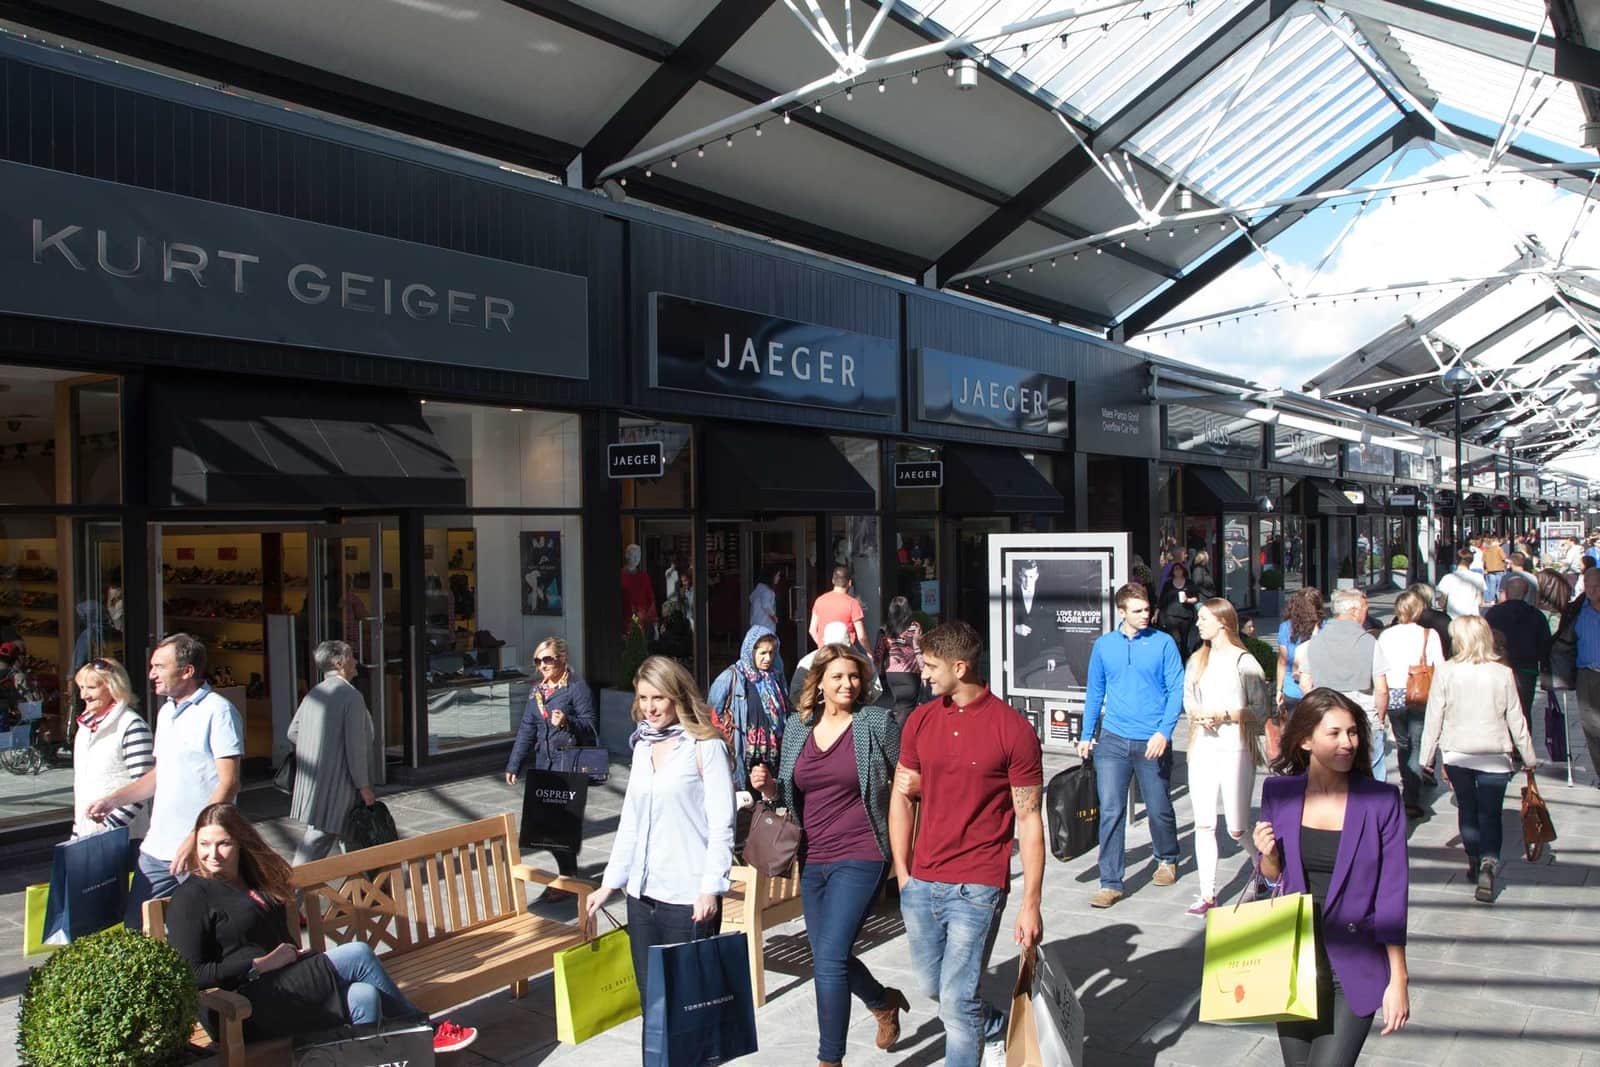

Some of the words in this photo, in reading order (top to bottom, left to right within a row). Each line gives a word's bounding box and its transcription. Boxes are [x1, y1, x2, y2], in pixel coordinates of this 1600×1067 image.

[32, 218, 260, 295] KURT
[287, 264, 515, 333] GEIGER
[717, 333, 856, 388] JAEGER
[960, 376, 1043, 415] JAEGER
[613, 454, 657, 466] JAEGER
[899, 470, 937, 479] JAEGER
[535, 789, 576, 799] OSPREY
[683, 1001, 706, 1012] TOMMY
